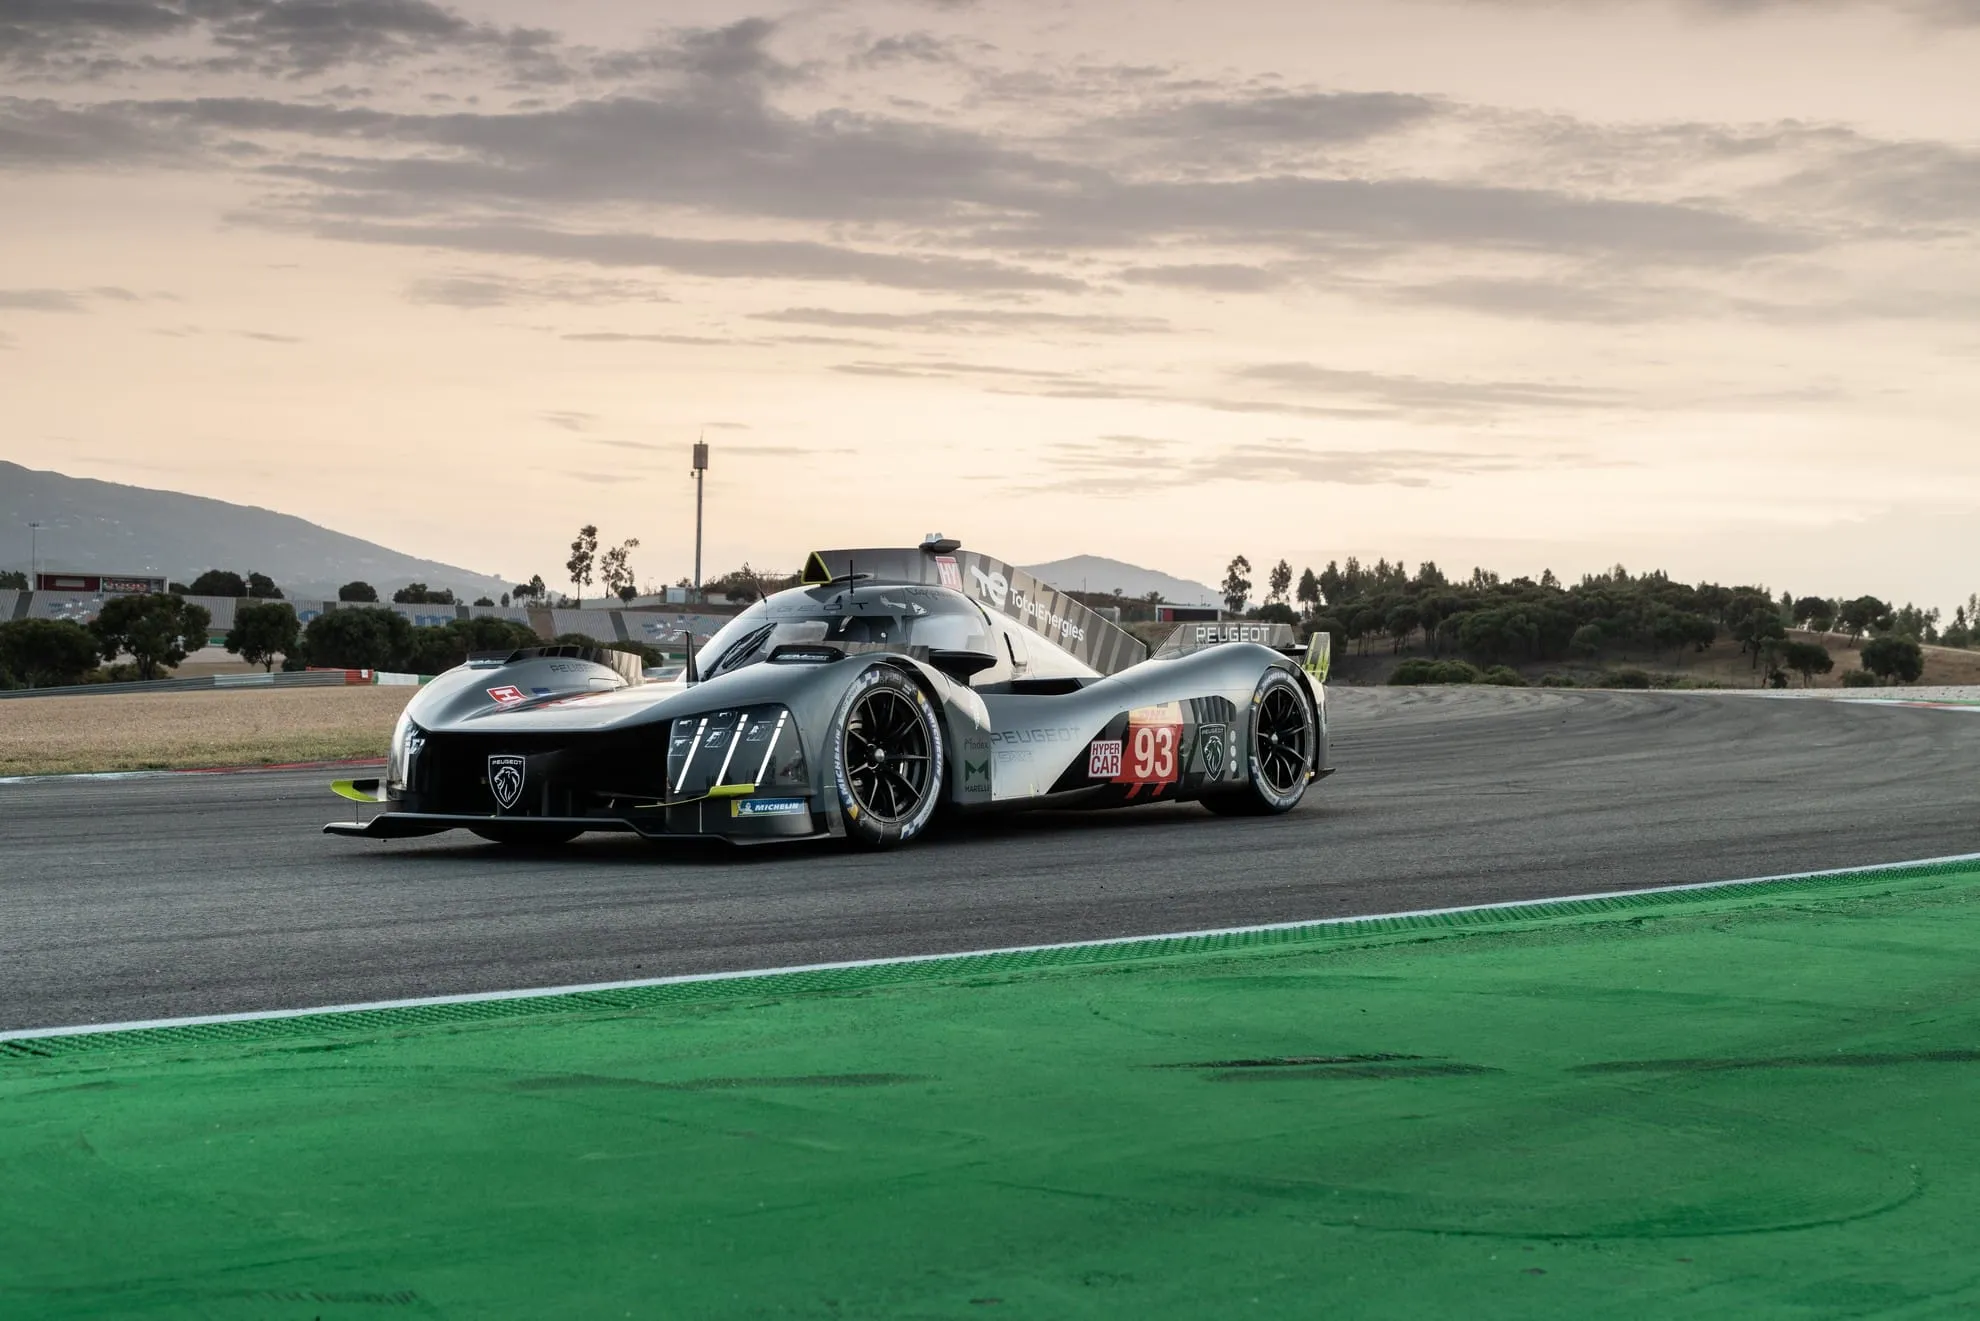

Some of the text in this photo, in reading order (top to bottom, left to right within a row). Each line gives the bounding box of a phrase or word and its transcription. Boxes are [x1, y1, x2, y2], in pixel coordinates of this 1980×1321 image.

[1010, 588, 1085, 642] TotalEnergies
[1196, 627, 1270, 642] PEUGEOT
[549, 663, 600, 674] PEUGE
[990, 728, 1080, 744] PEUGEOT
[1092, 742, 1120, 755] HYPER
[1134, 728, 1173, 778] 93
[1091, 756, 1119, 774] CAR
[754, 803, 800, 811] MICHELIN
